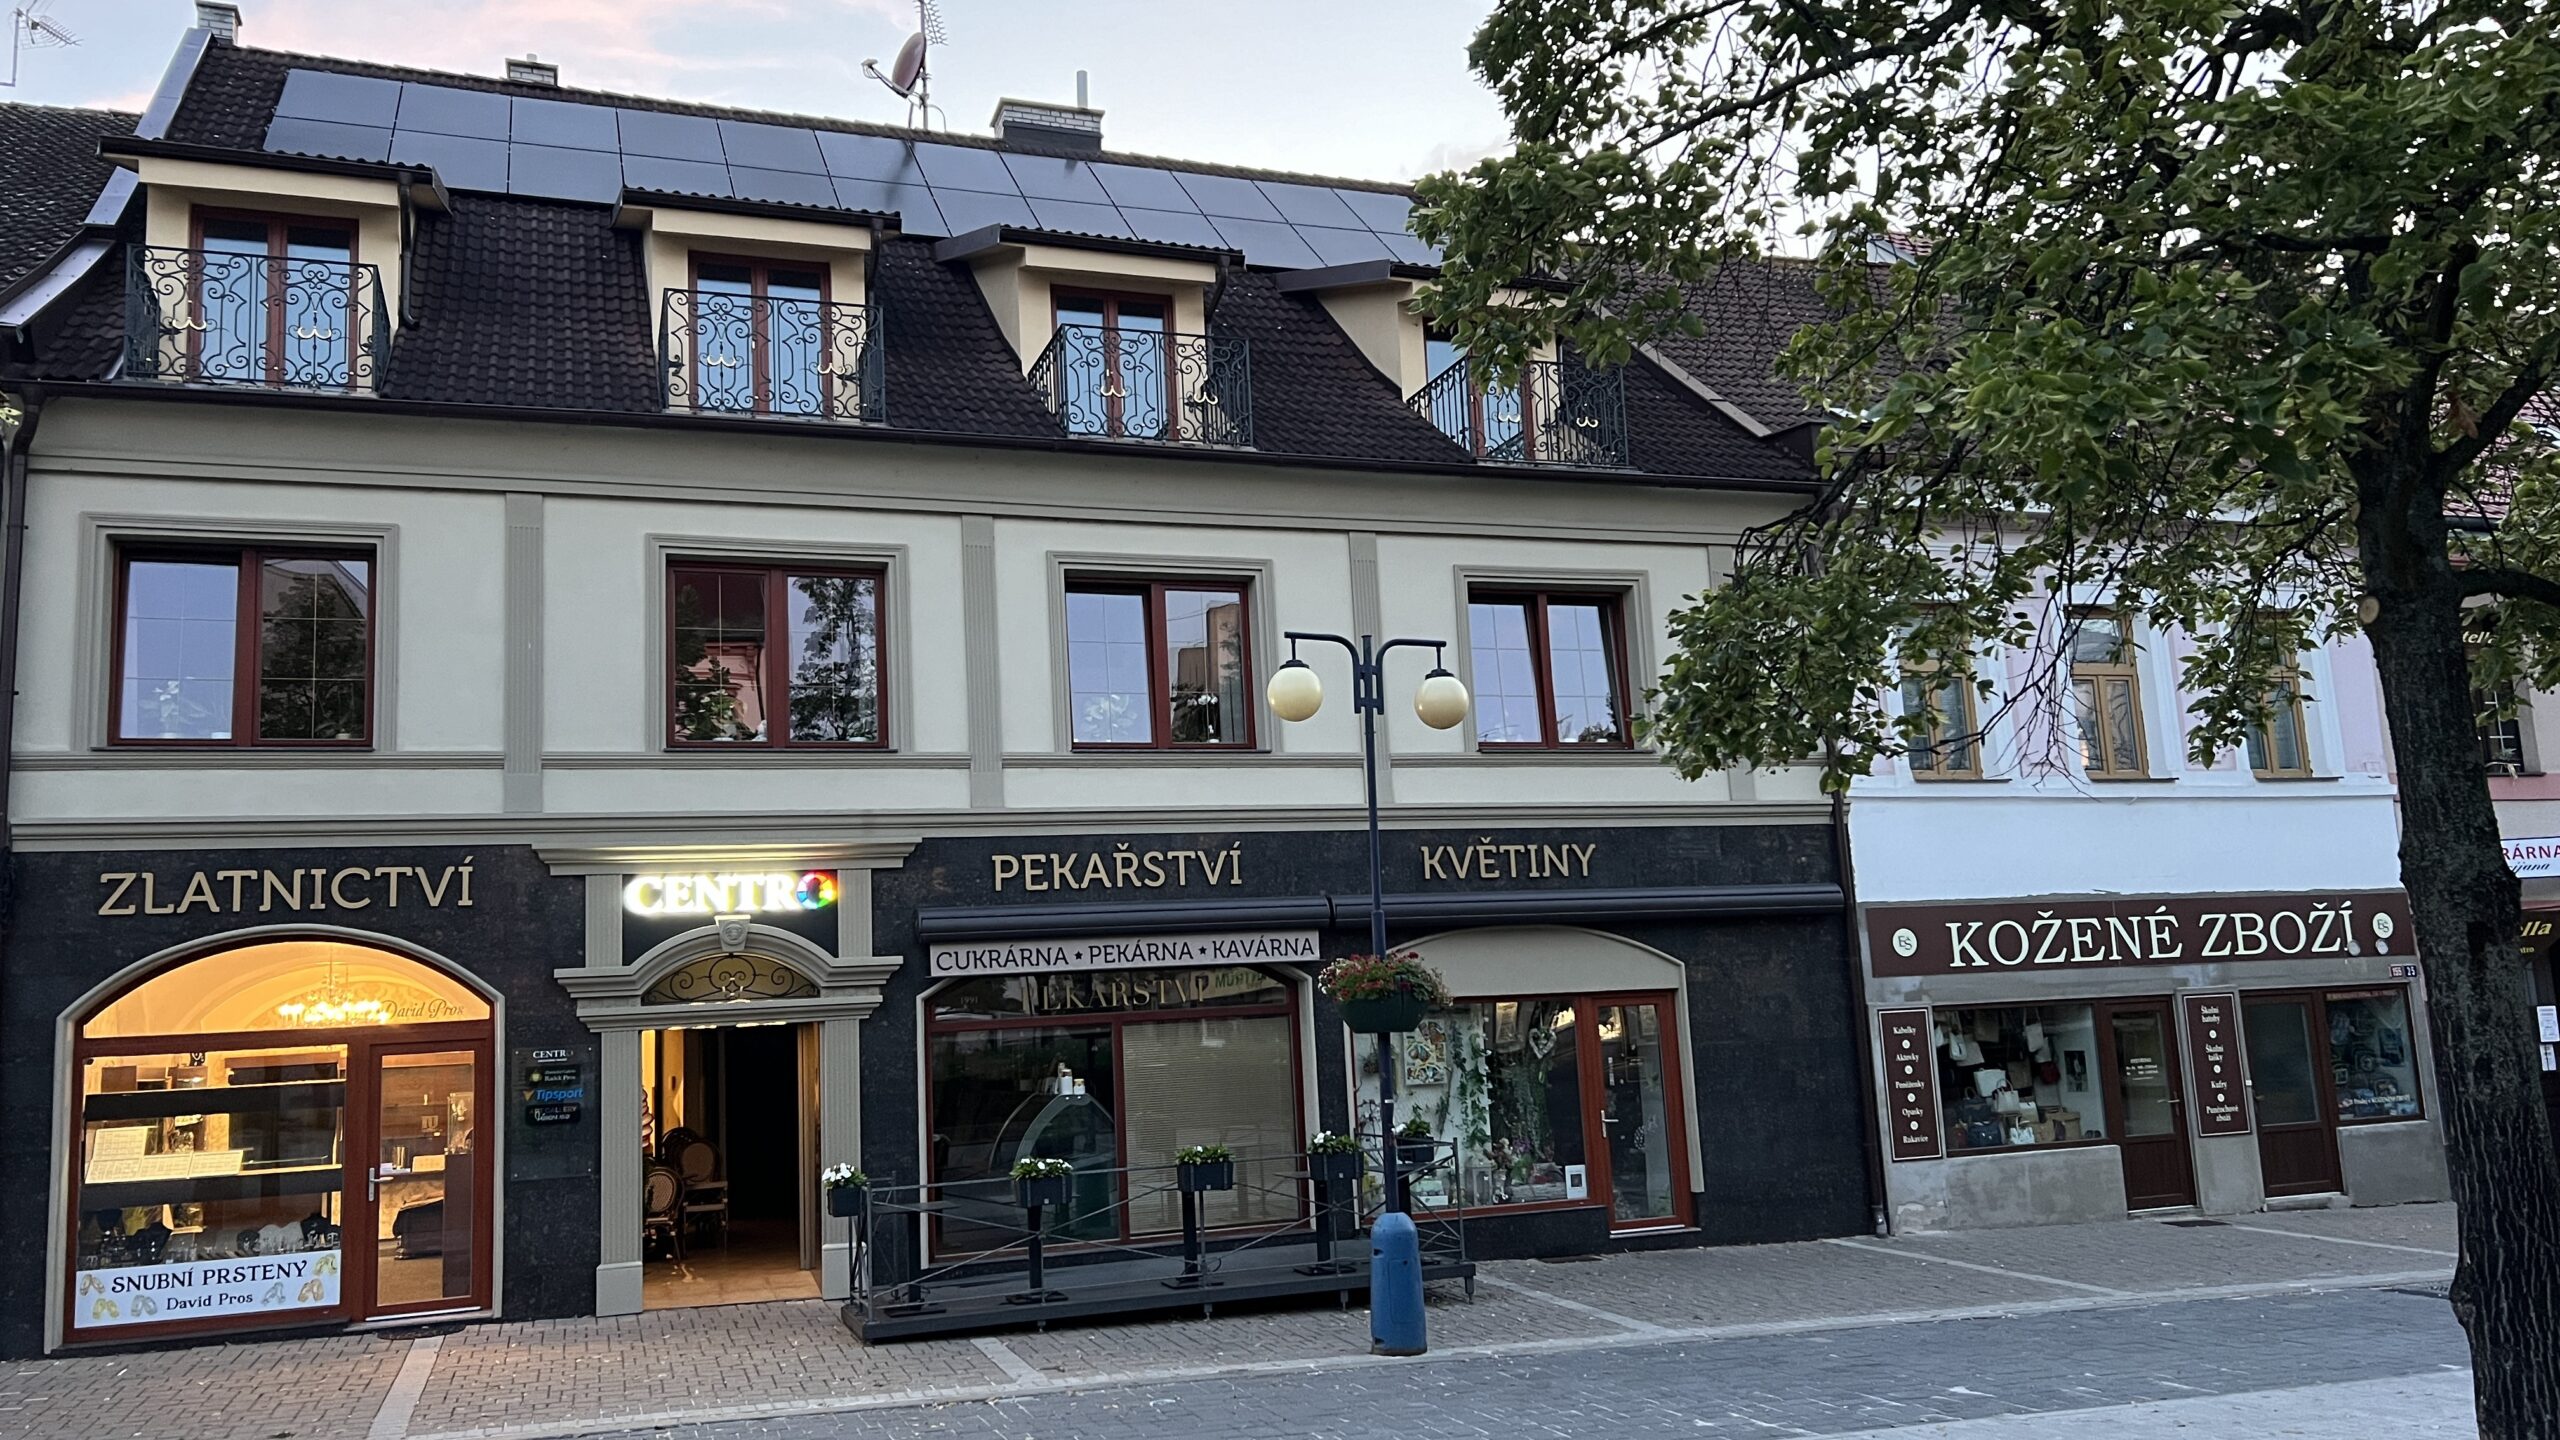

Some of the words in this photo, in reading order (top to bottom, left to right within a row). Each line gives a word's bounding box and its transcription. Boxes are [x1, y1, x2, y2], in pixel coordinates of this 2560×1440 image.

[992, 841, 1242, 892] PEKAŘSTVÍ
[1420, 836, 1596, 880] KVĚTINY
[2502, 843, 2560, 860] RÁRNA
[98, 855, 474, 916] ZLATNICTVÍ
[624, 871, 834, 915] CENTRO
[1945, 905, 2183, 968] KOŽENÉ
[2199, 901, 2354, 958] ZBOŽÍ
[2520, 920, 2552, 937] lla
[936, 944, 1069, 971] CUKRÁRNA
[1088, 939, 1193, 965] PEKÁRNA
[1212, 933, 1315, 959] KAVÁRNA
[536, 1088, 584, 1101] Tipsport
[111, 1267, 193, 1293] SNUBNÍ
[202, 1260, 308, 1286] PRSTENY
[166, 1294, 212, 1310] David
[218, 1292, 253, 1306] Pros
